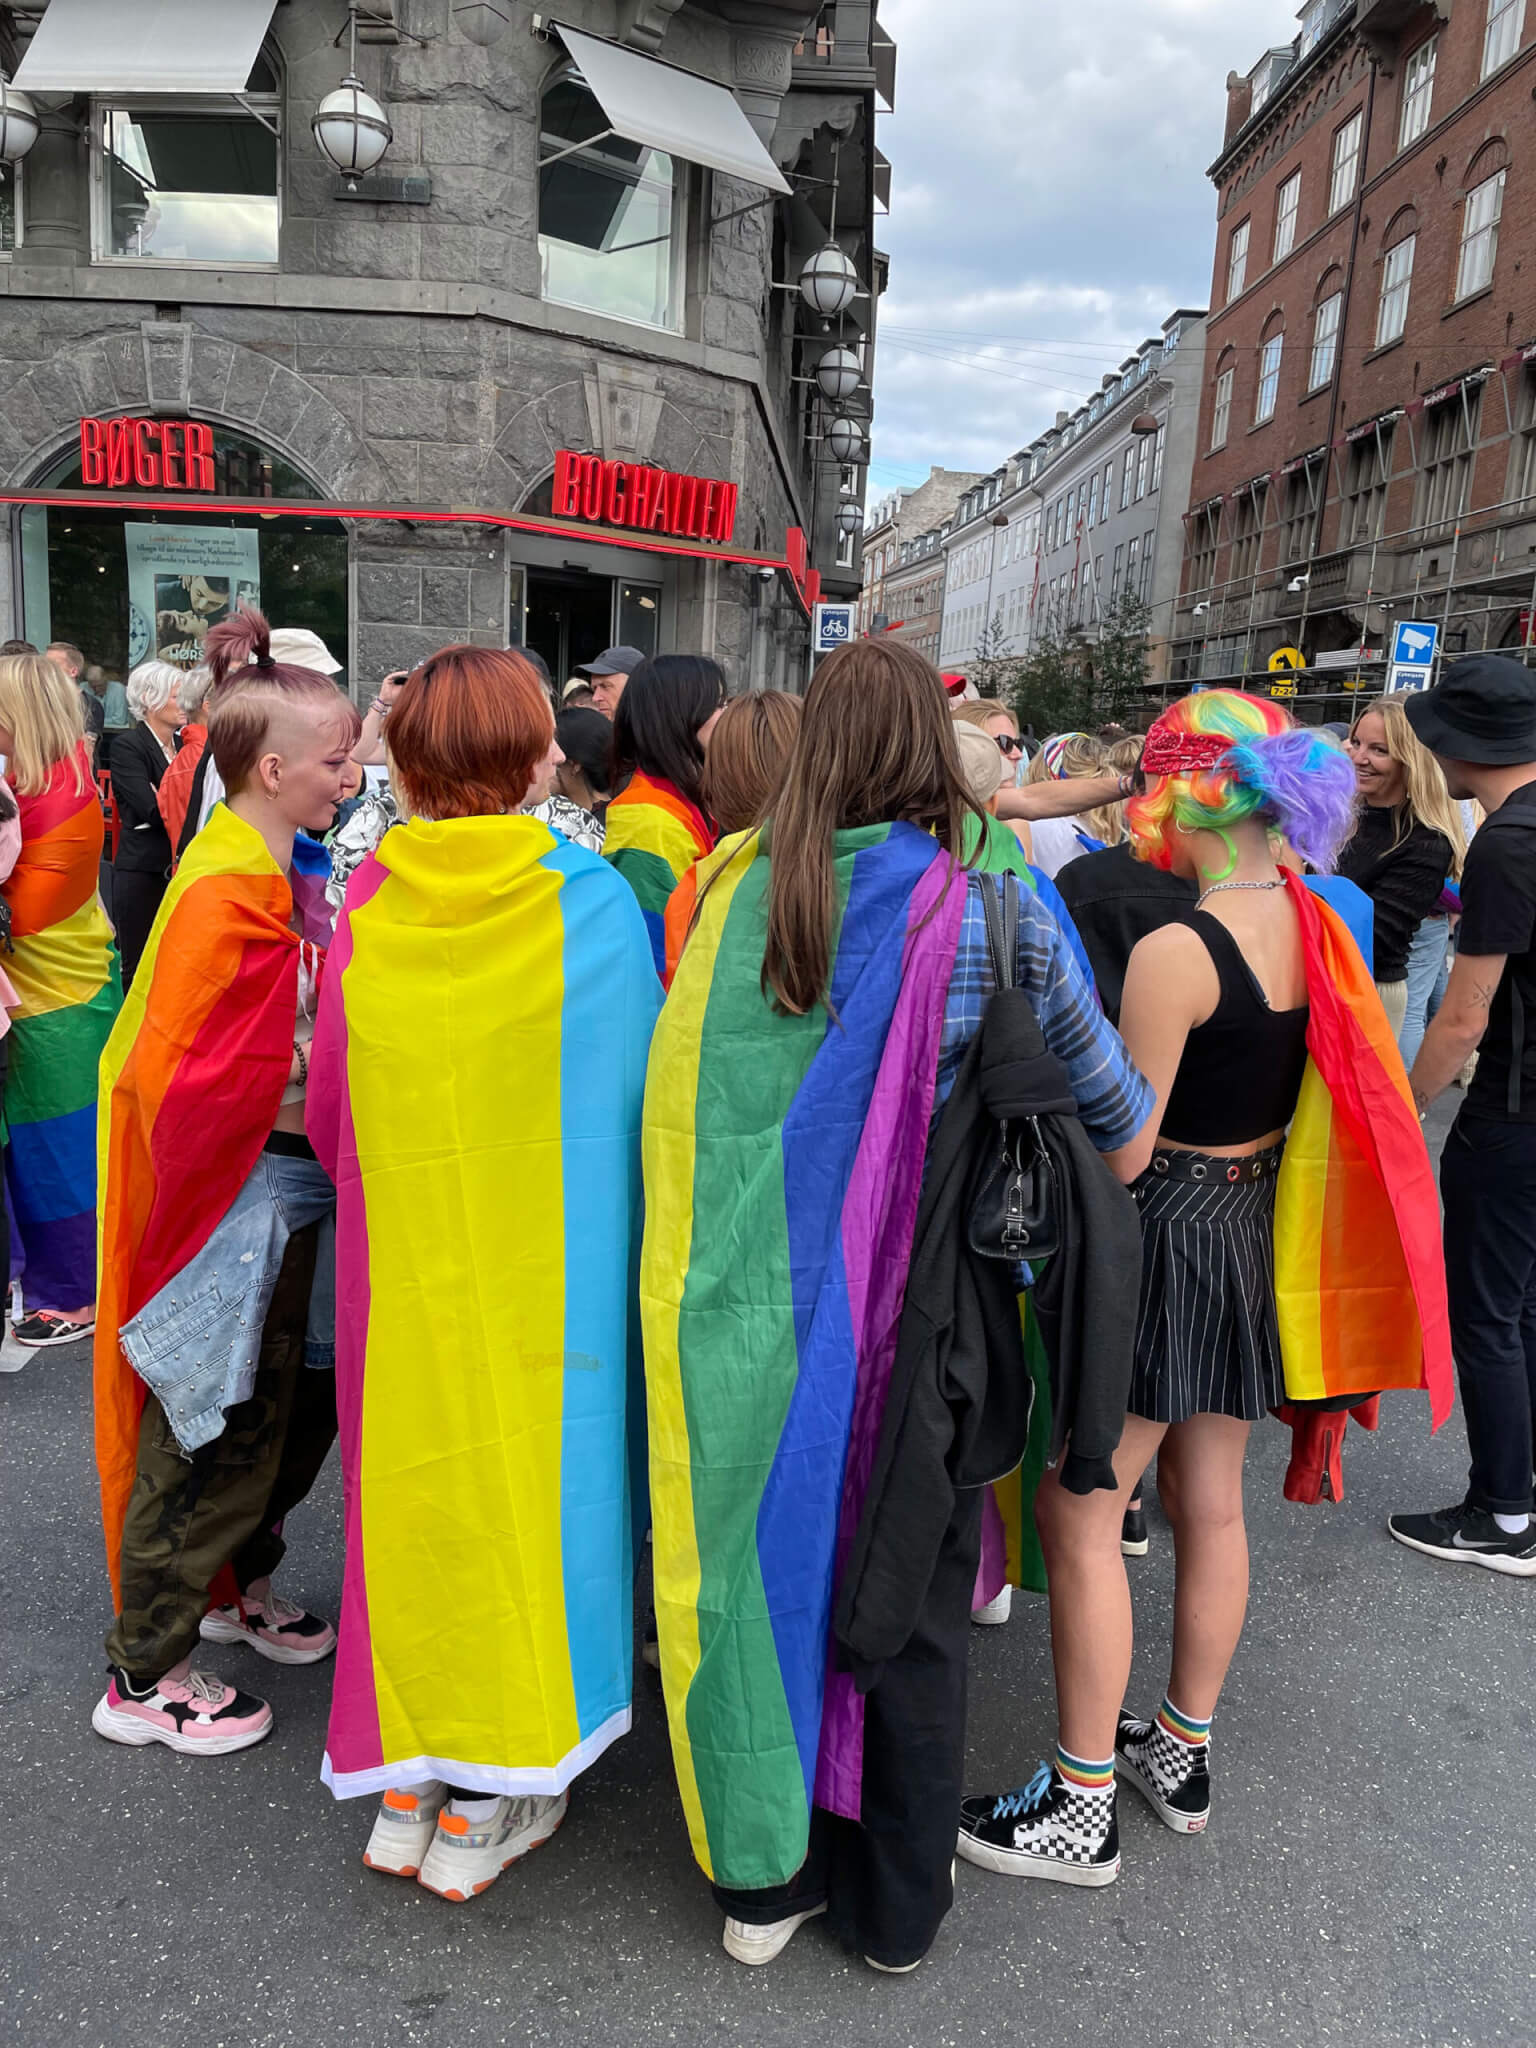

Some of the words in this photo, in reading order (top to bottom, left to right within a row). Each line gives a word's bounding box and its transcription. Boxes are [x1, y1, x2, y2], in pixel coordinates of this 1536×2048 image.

[80, 416, 215, 491] BØGER
[552, 450, 737, 541] BOGHALLEN
[169, 648, 205, 661] HØRS
